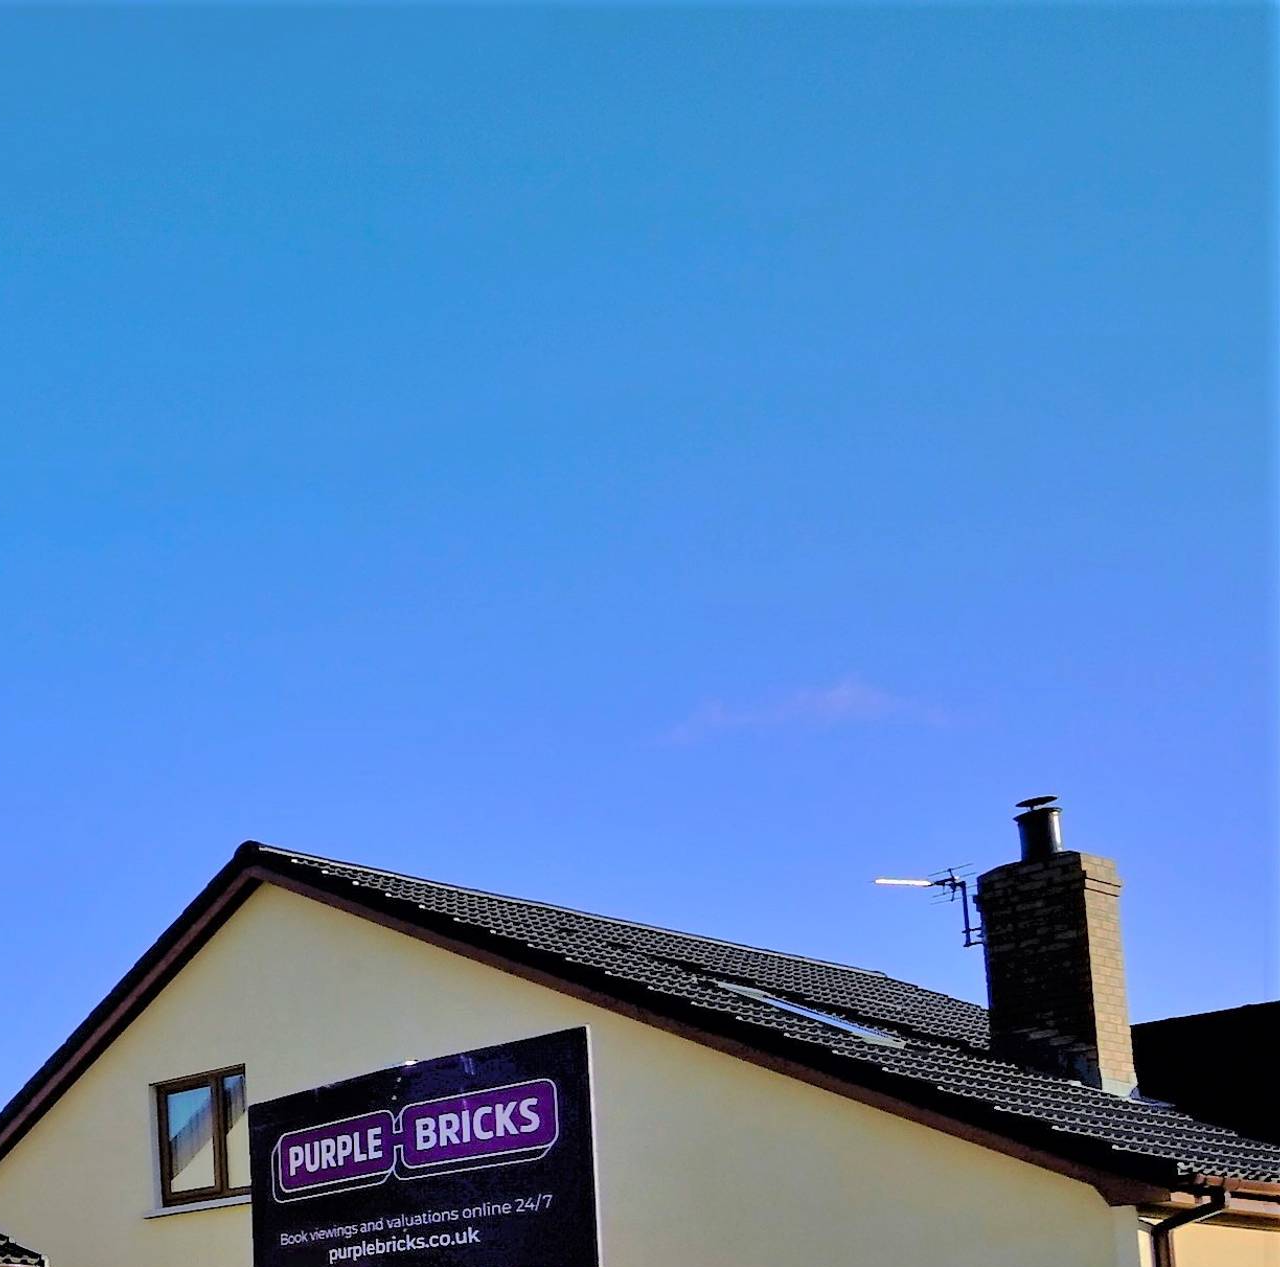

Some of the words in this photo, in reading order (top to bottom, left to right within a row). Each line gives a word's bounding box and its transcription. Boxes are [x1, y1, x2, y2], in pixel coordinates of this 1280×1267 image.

[289, 1127, 383, 1176] PURPLE
[416, 1098, 540, 1150] BRICKS
[280, 1231, 308, 1246] Book
[308, 1223, 358, 1242] viewings
[359, 1218, 383, 1234] and
[386, 1209, 459, 1230] valuations
[462, 1202, 511, 1217] online
[515, 1194, 553, 1213] 24/7
[329, 1227, 480, 1265] purplebricks.co.uk
